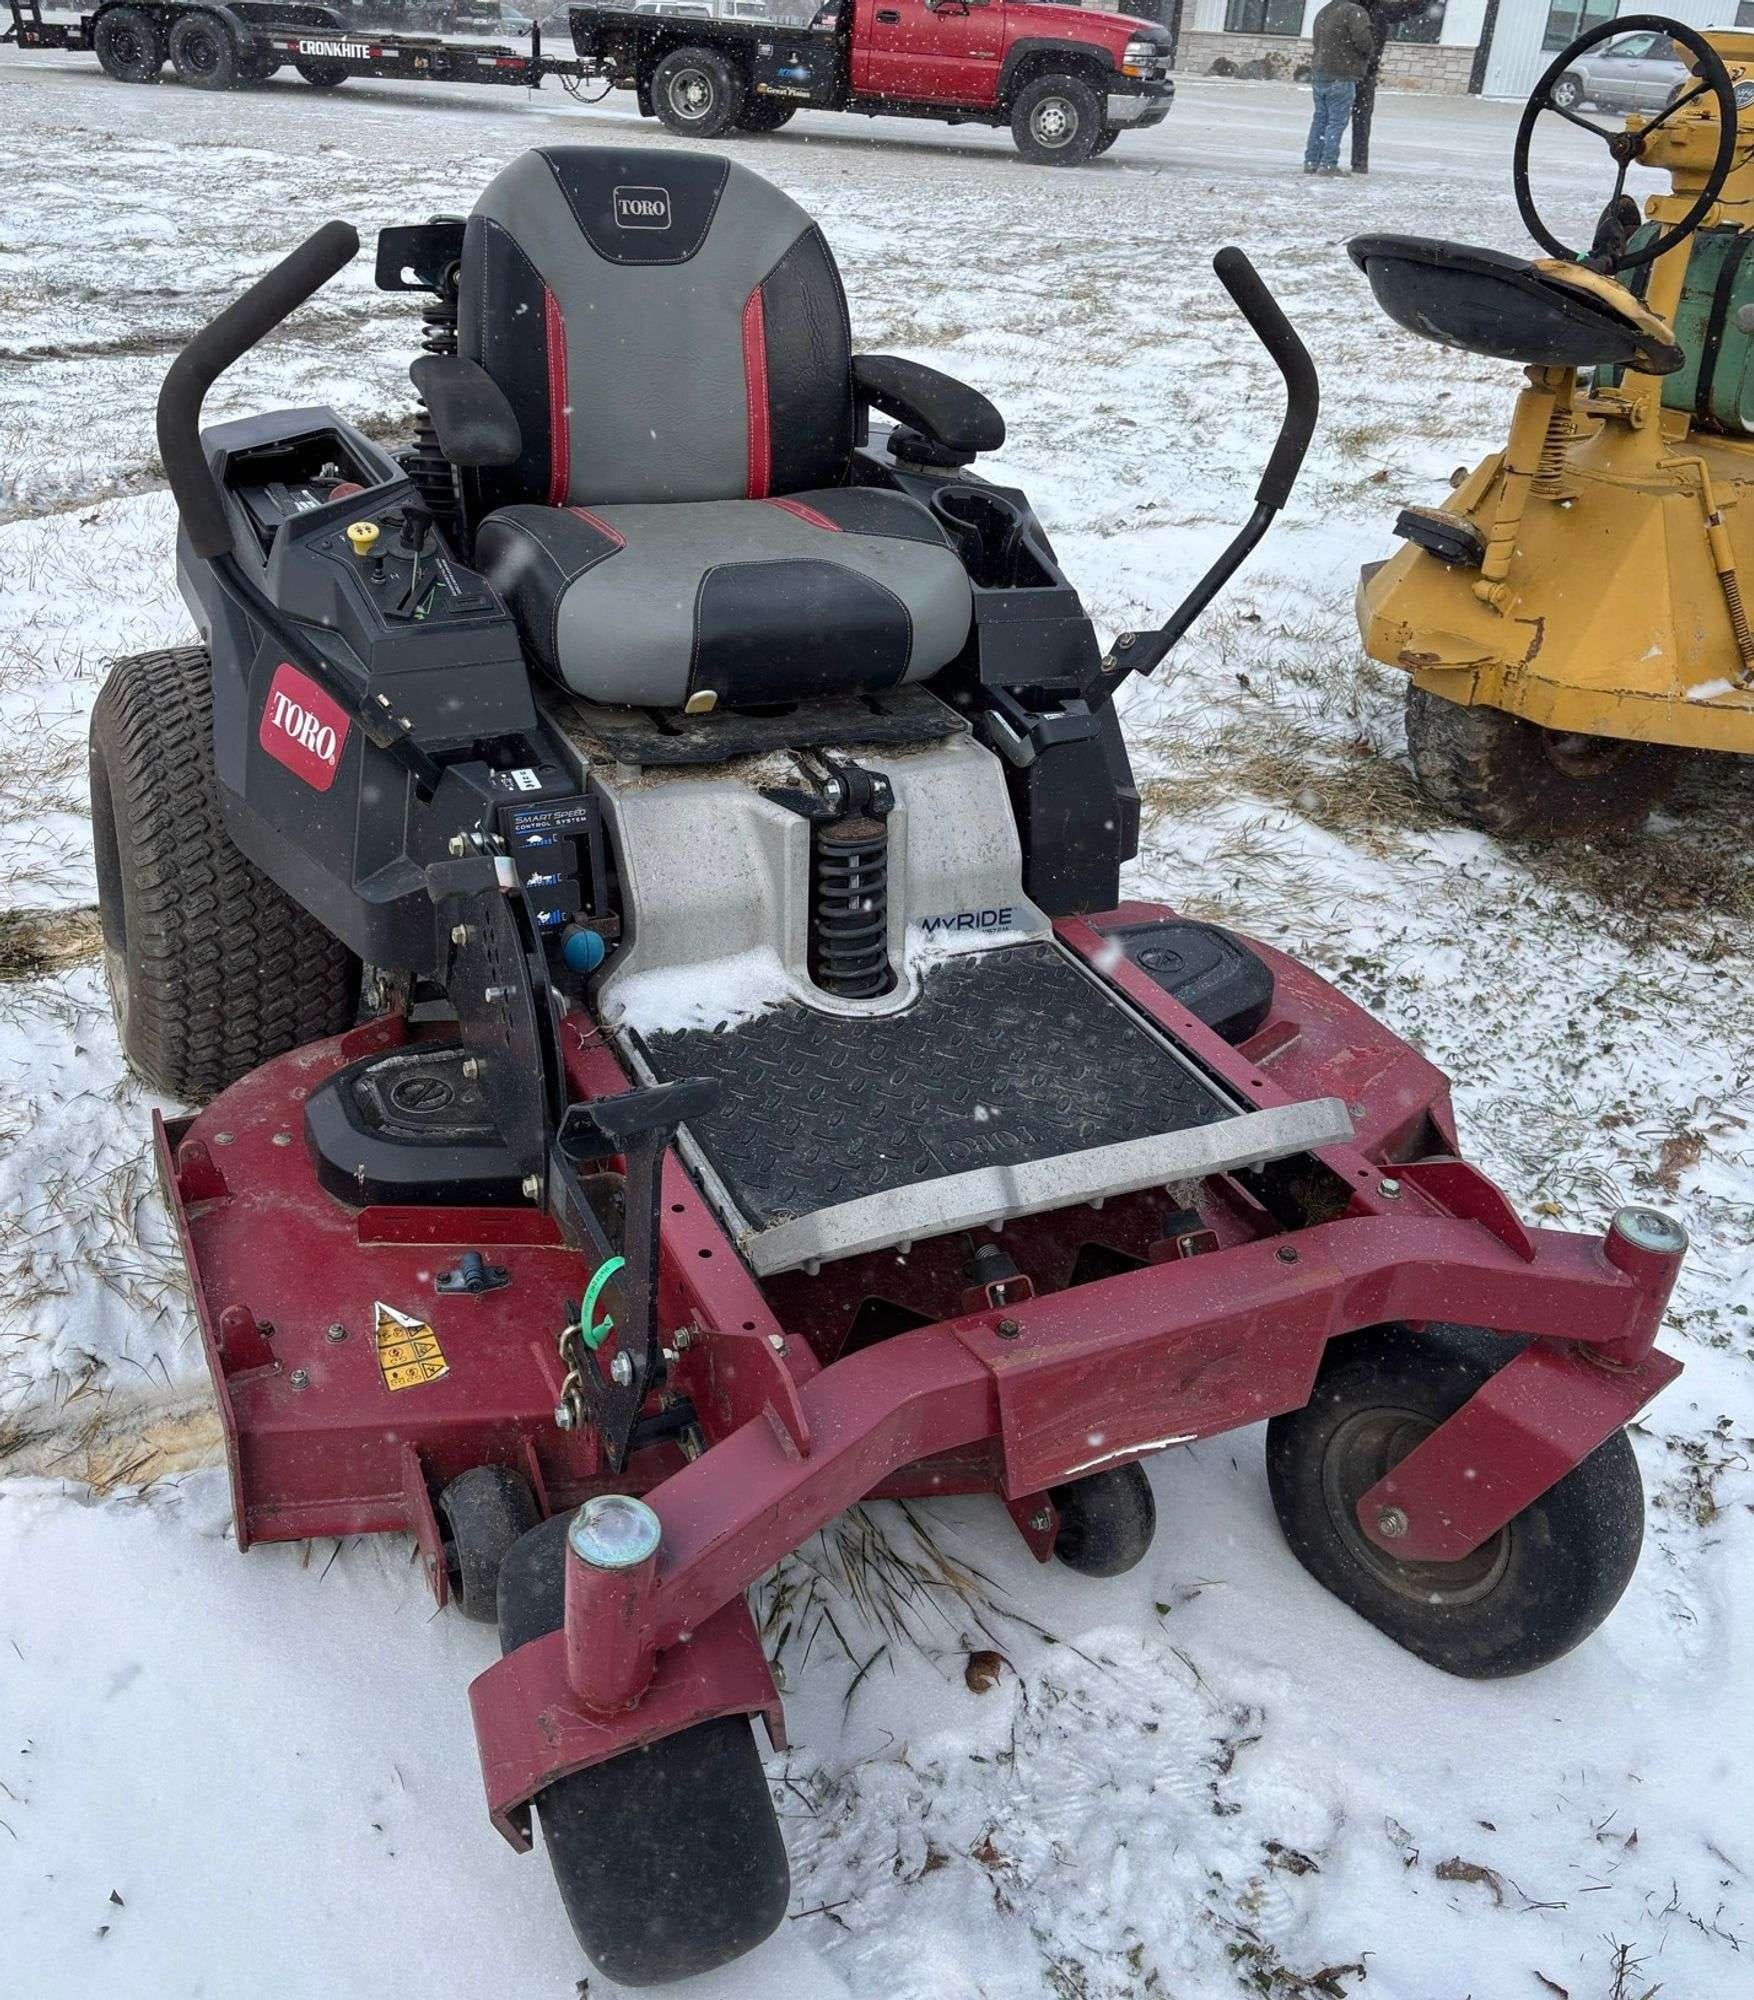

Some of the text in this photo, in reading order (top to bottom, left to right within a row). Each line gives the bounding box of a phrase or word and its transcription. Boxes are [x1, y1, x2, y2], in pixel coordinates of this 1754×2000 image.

[299, 40, 371, 59] CRONKHITE
[618, 199, 665, 216] TORO
[272, 691, 336, 760] TORO
[515, 814, 552, 824] SMART
[515, 816, 586, 830] CONTROL SYSTEM
